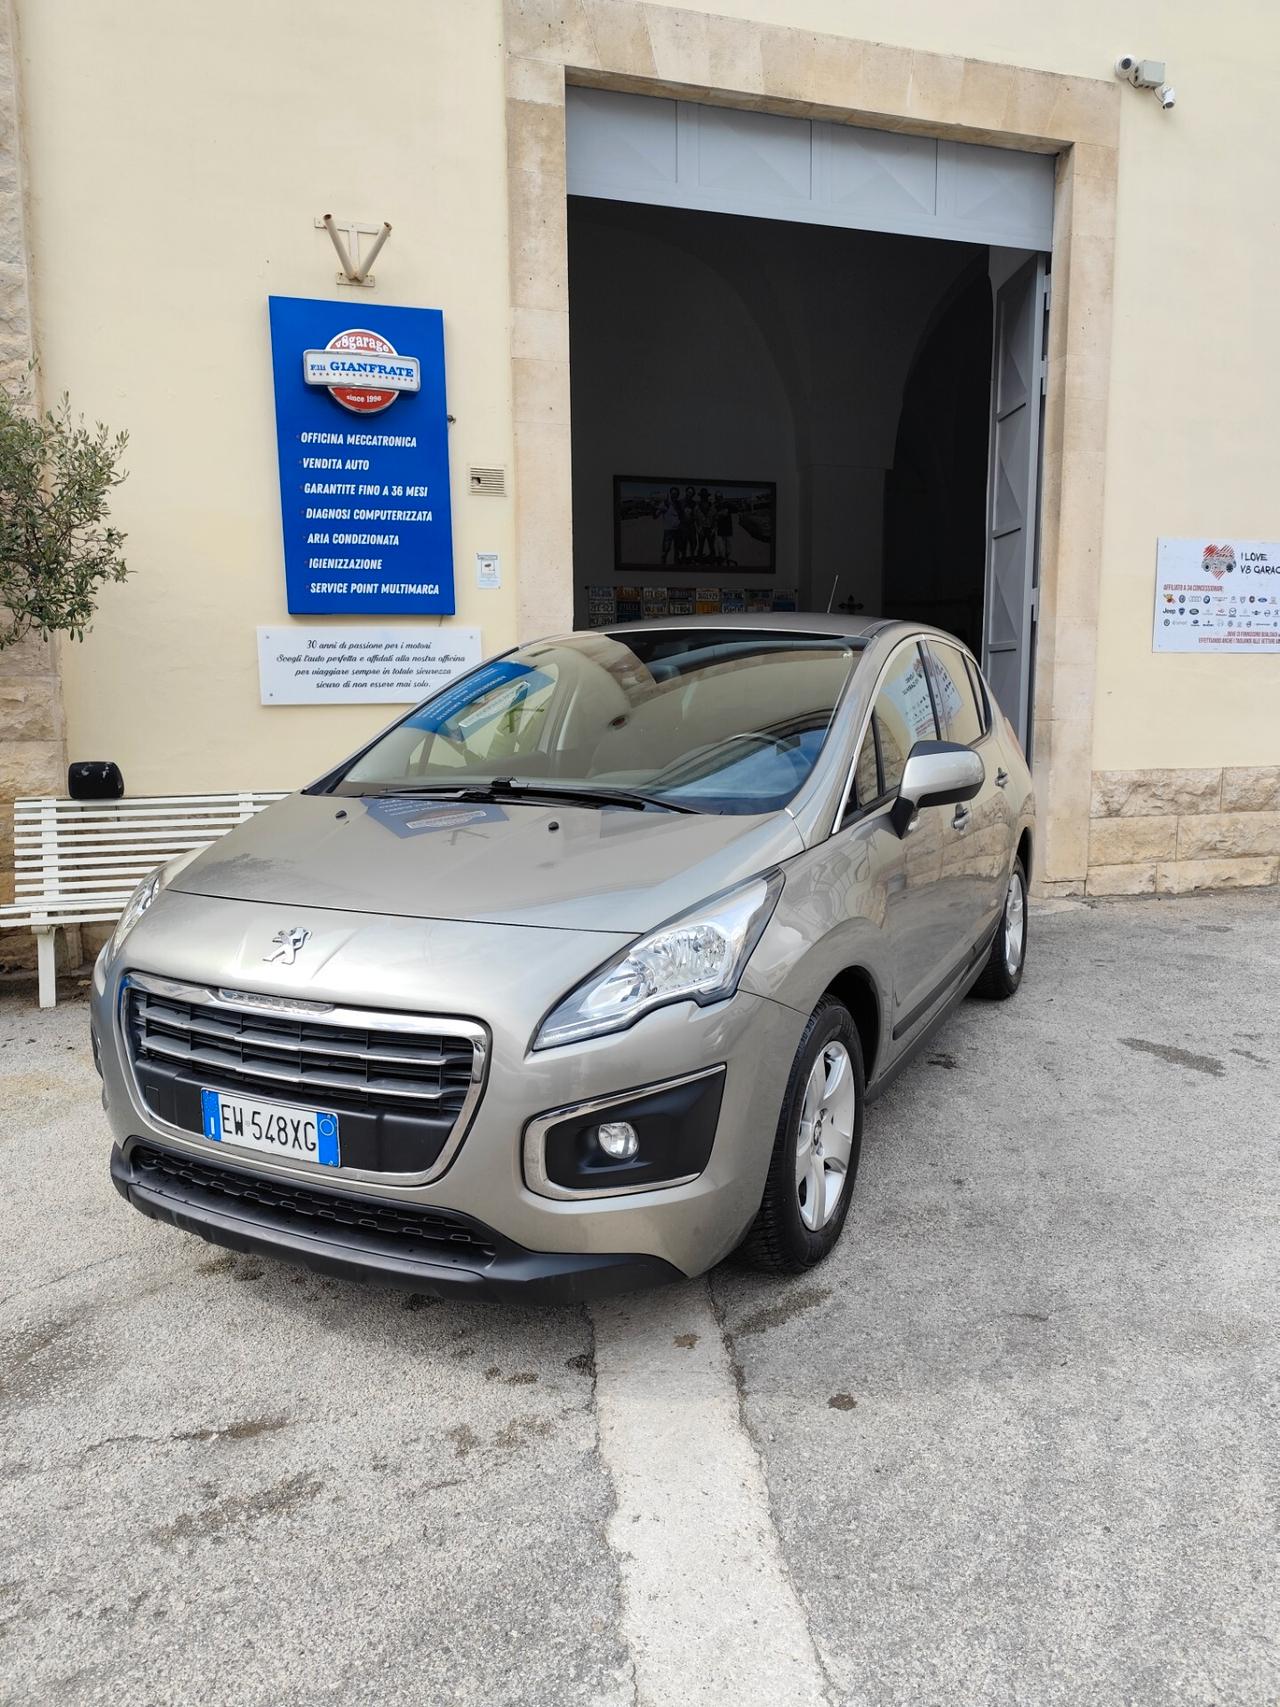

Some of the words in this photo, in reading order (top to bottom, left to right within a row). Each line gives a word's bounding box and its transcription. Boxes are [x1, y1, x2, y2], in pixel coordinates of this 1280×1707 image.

[330, 361, 414, 378] GIANFRATE
[346, 394, 365, 403] since
[301, 432, 343, 444] OFFICINA
[347, 434, 417, 448] MECCATRONICA
[303, 458, 342, 470] VENDITA
[344, 459, 369, 470] AUTO
[304, 483, 356, 495] GARANTITE
[358, 485, 380, 495] FINO
[382, 486, 389, 496] A
[391, 486, 403, 496] 36
[406, 487, 428, 497] MESI
[306, 508, 351, 519] DIAGNOSI
[353, 509, 433, 522] COMPUTERIZZATA
[307, 533, 330, 544] ARIA
[332, 534, 399, 546] CONDIZIONATA
[1240, 552, 1244, 560] I
[1245, 552, 1268, 561] LOVE
[309, 558, 383, 569] IGIENIZZAZIONE
[1240, 564, 1252, 574] V8
[310, 583, 348, 594] SERVICE
[350, 583, 379, 594] POINT
[381, 584, 440, 595] MULTIMARCA
[306, 639, 318, 649] 30
[338, 641, 347, 649] di
[347, 641, 383, 650] passione
[384, 642, 398, 650] per
[405, 641, 432, 649] motori
[276, 653, 302, 664] Scegli
[326, 654, 357, 664] perfetta
[366, 654, 394, 664] affidati
[395, 654, 410, 662] alla
[411, 655, 436, 663] nostra
[438, 654, 466, 664] officina
[294, 668, 309, 677] per
[311, 667, 349, 676] viaggiare
[351, 668, 380, 676] sempre
[382, 667, 390, 675] in
[392, 666, 414, 675] totale
[416, 667, 451, 675] sicurezza
[316, 680, 340, 688] sicuro
[342, 680, 351, 688] di
[396, 680, 412, 688] mai
[413, 680, 431, 688] solo.
[221, 1104, 244, 1137] EW
[251, 1110, 317, 1152] 548XG
